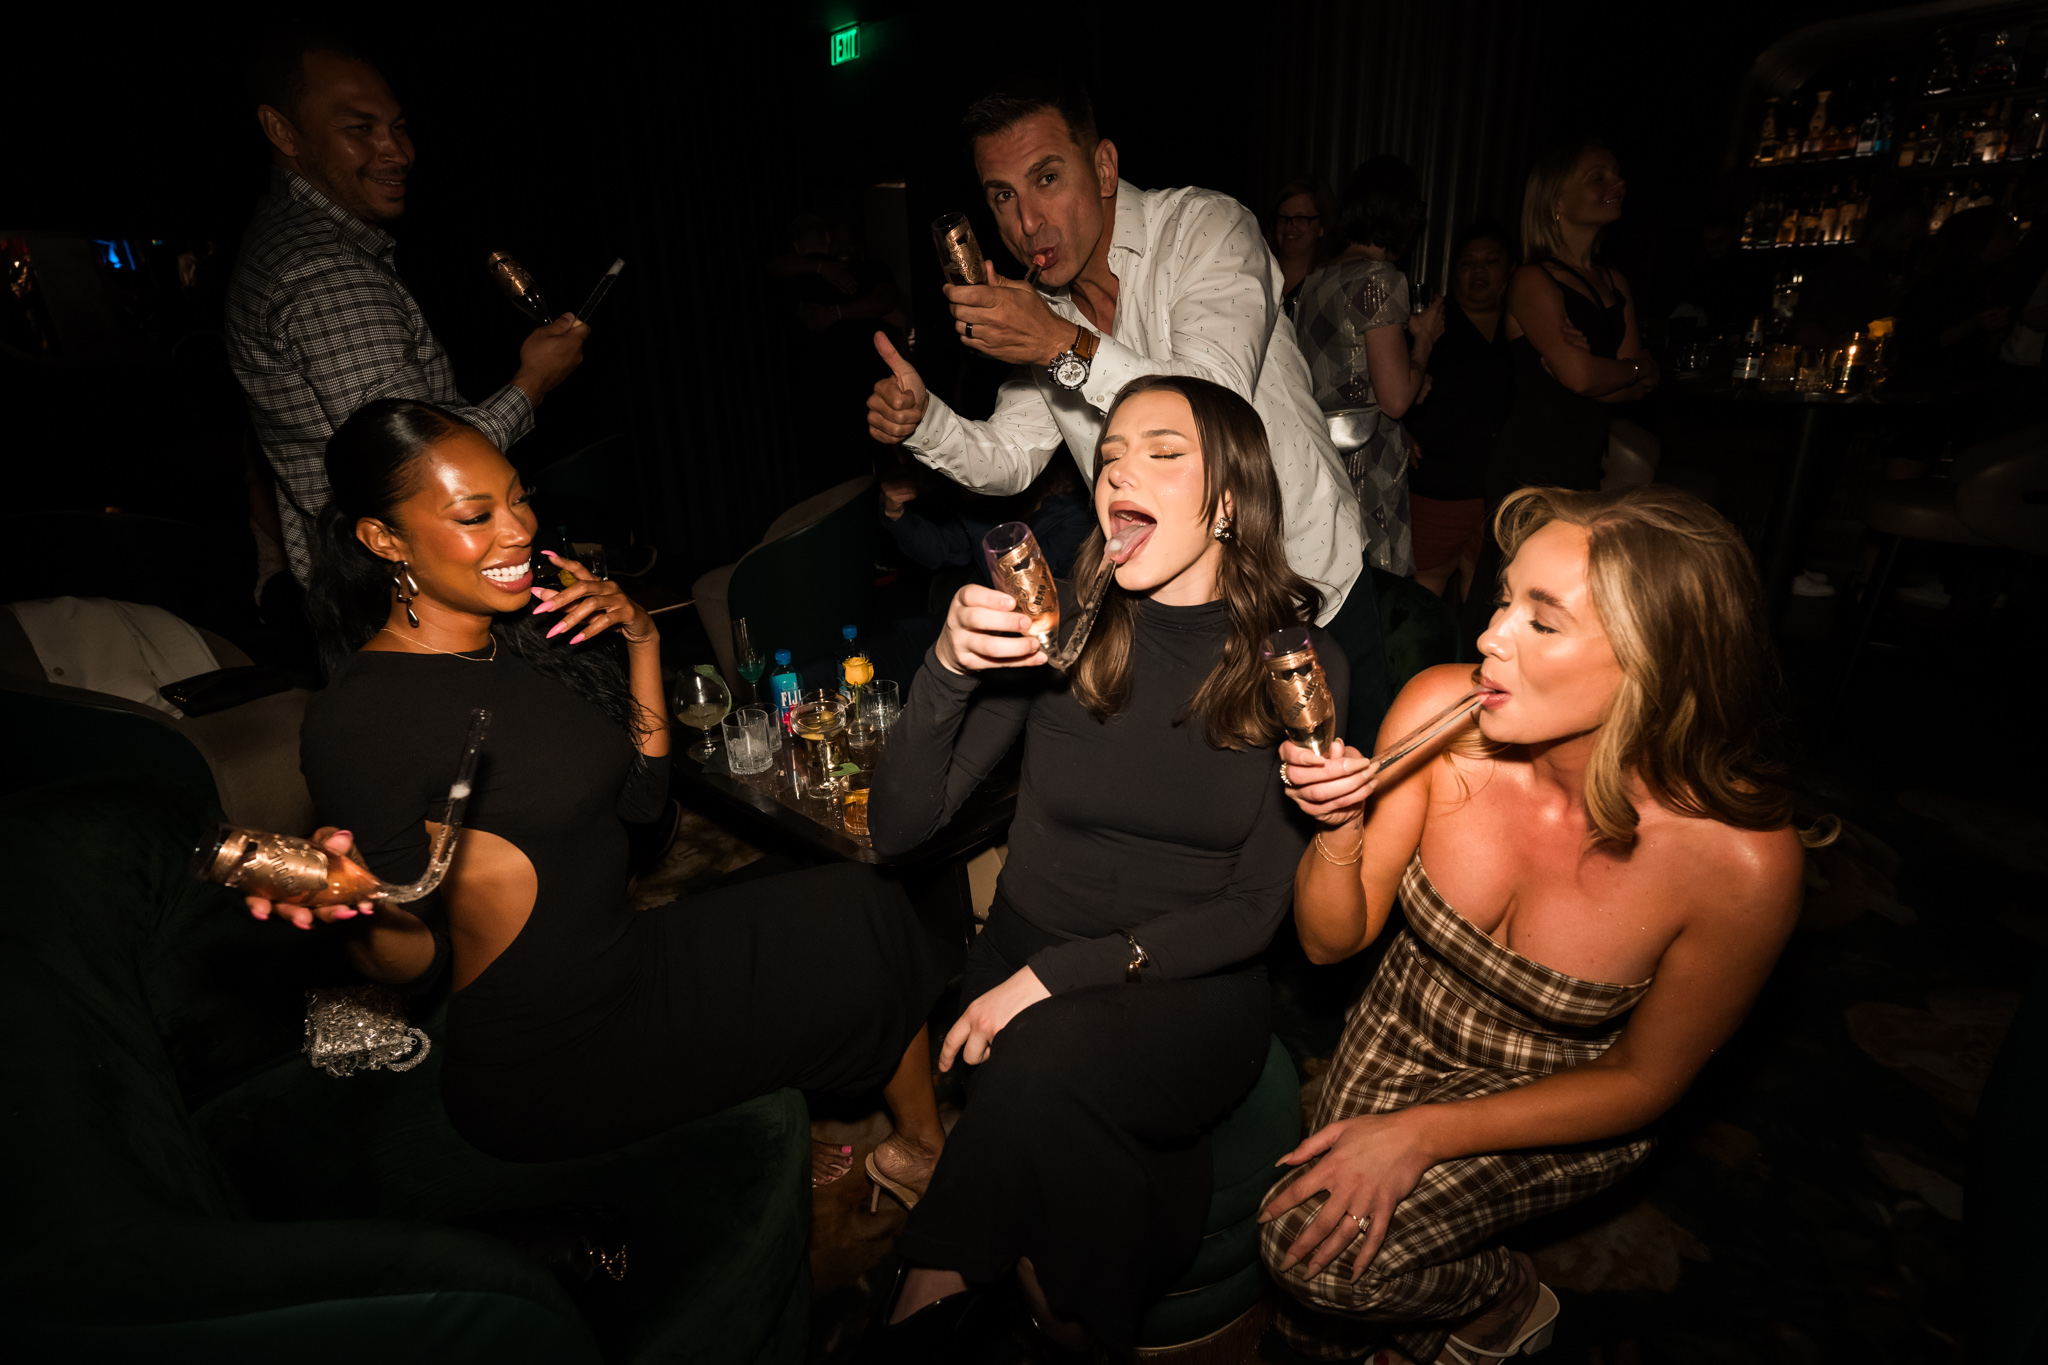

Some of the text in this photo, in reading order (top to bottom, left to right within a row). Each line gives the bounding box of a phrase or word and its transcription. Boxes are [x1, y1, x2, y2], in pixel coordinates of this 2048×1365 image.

[835, 28, 857, 63] EXIT
[780, 689, 804, 707] FIJI
[1301, 681, 1317, 702] JOIE
